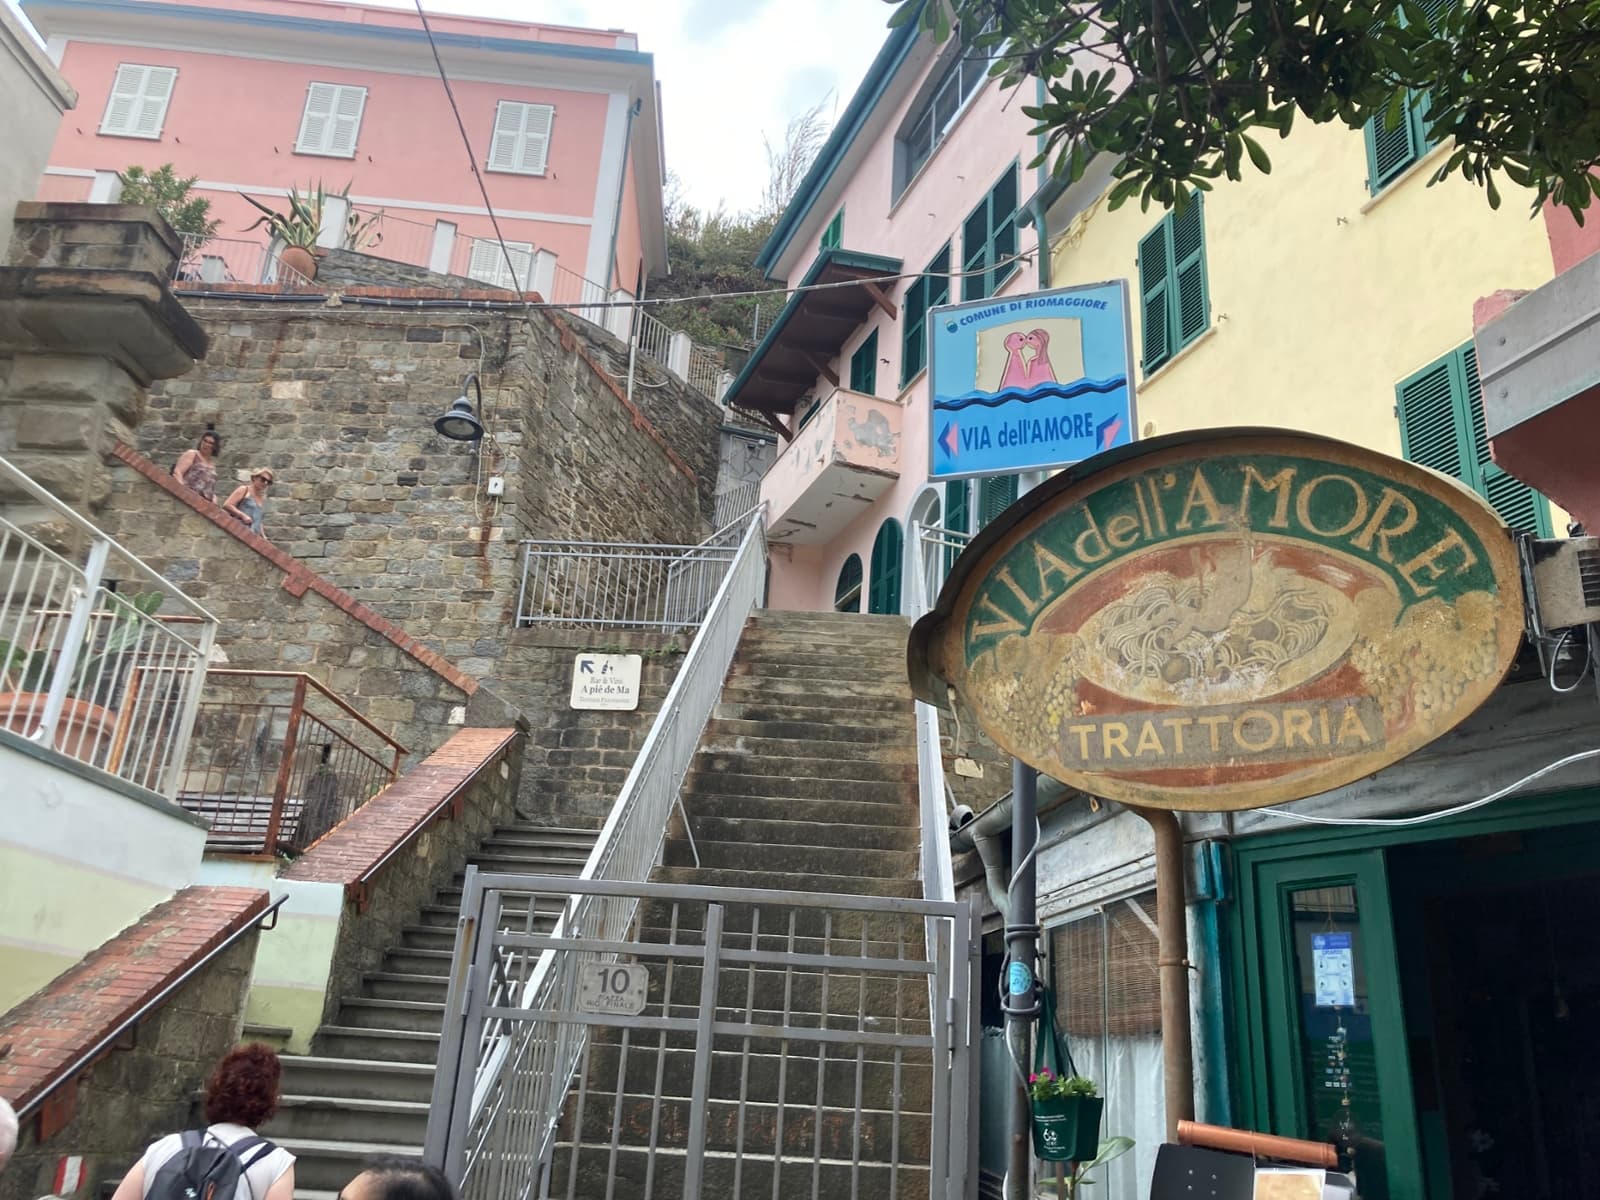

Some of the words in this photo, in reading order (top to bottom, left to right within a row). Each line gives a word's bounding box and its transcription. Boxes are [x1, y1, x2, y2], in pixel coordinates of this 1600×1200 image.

[960, 305, 1006, 326] COMUNE
[1010, 302, 1022, 312] DI
[1026, 297, 1108, 310] RIOMAGGIORE
[961, 426, 992, 452] VIA
[998, 412, 1094, 448] dell'AMORE
[972, 542, 1083, 643] VIA
[1074, 465, 1477, 595] dell'AMORE
[1070, 706, 1369, 761] TRATTORIA
[598, 968, 630, 994] 10
